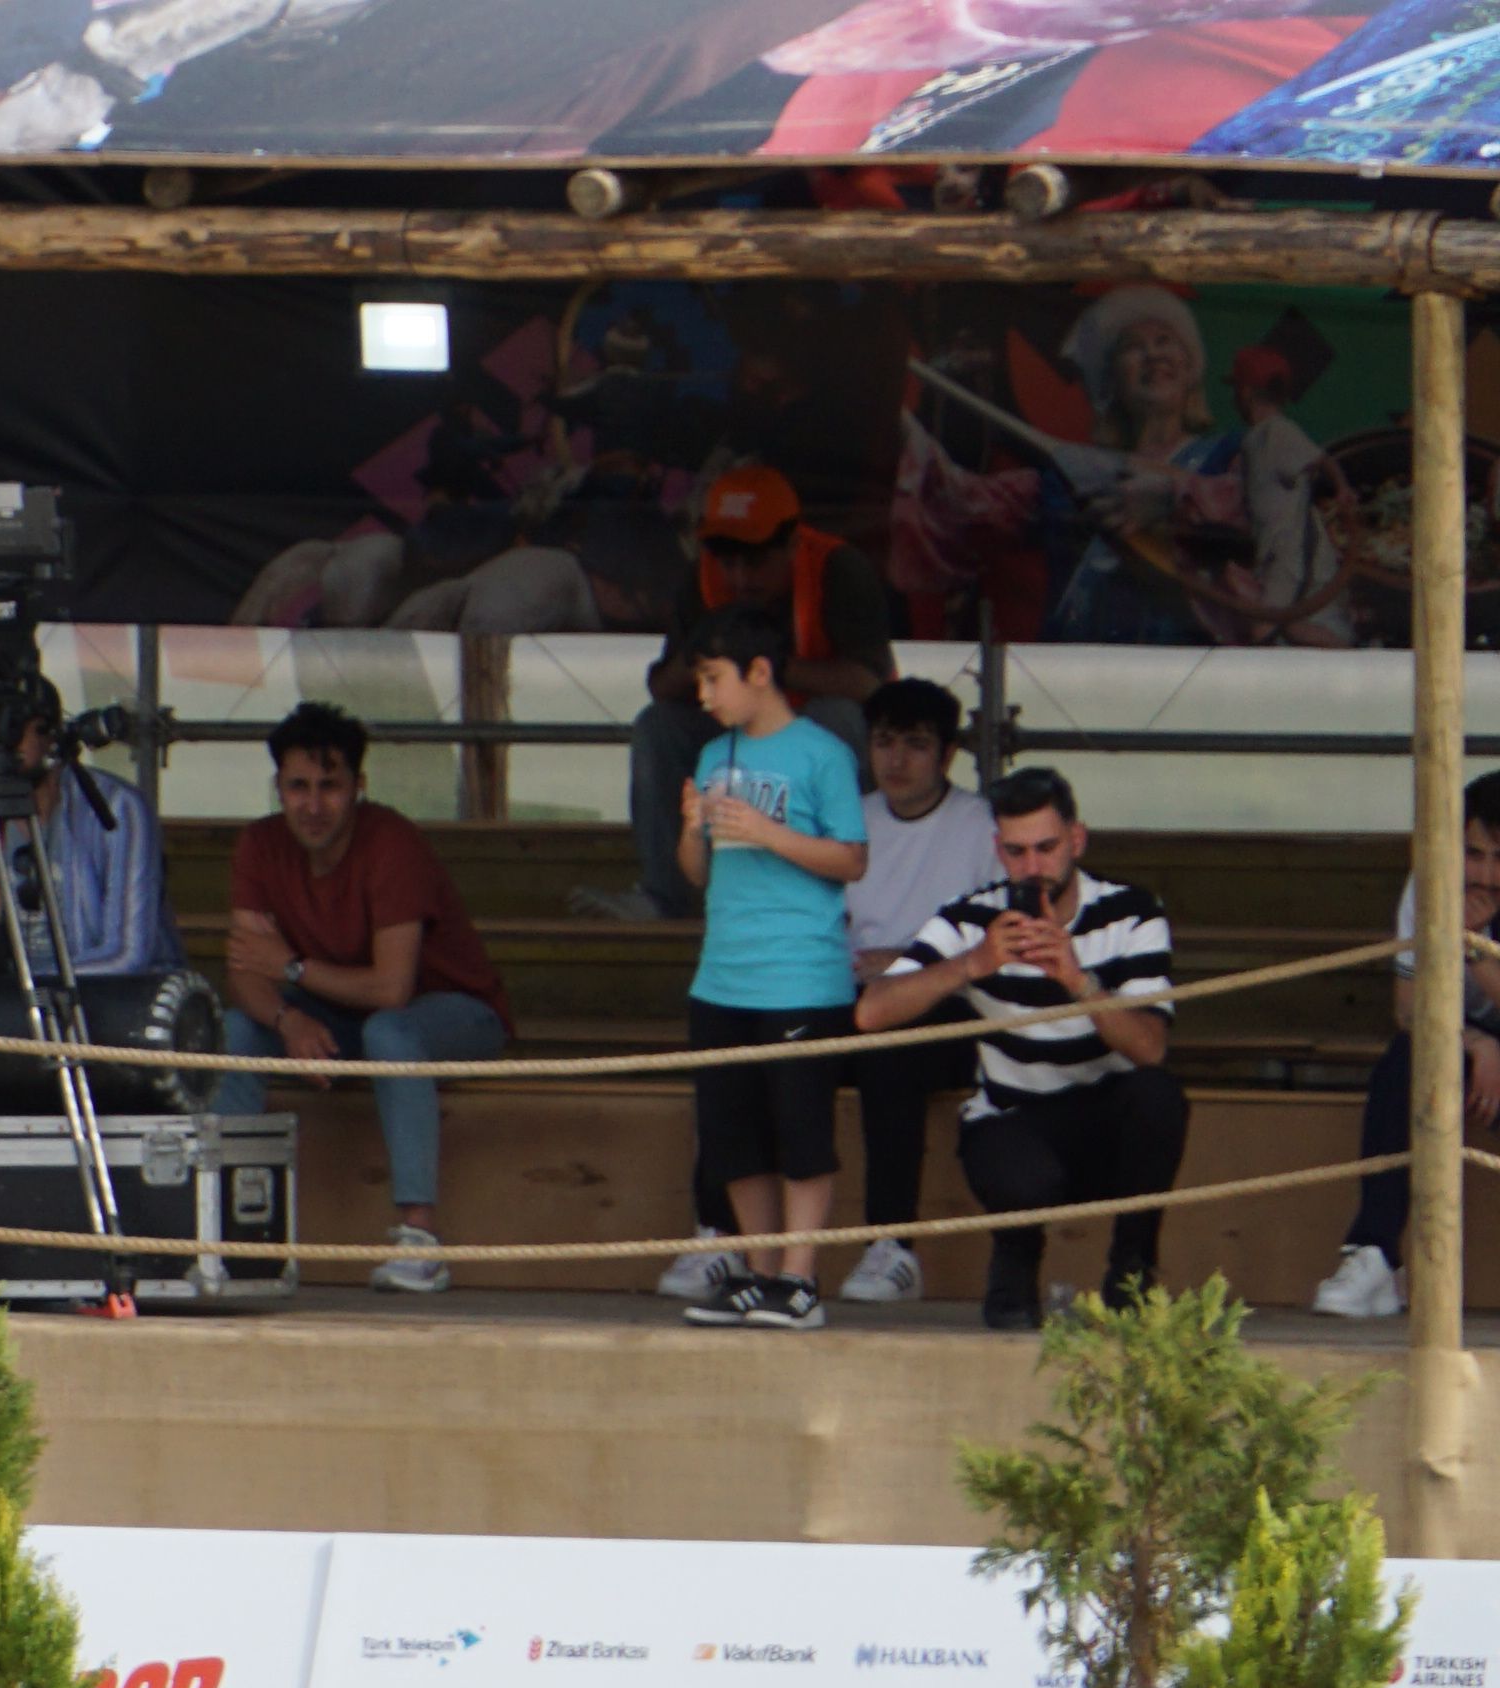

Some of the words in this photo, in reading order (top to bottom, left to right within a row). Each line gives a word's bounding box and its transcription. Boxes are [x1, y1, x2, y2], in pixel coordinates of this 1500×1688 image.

[546, 1640, 590, 1658] Ziraat
[879, 1647, 989, 1667] HALKBANK
[1410, 1672, 1484, 1687] AIRLINES
